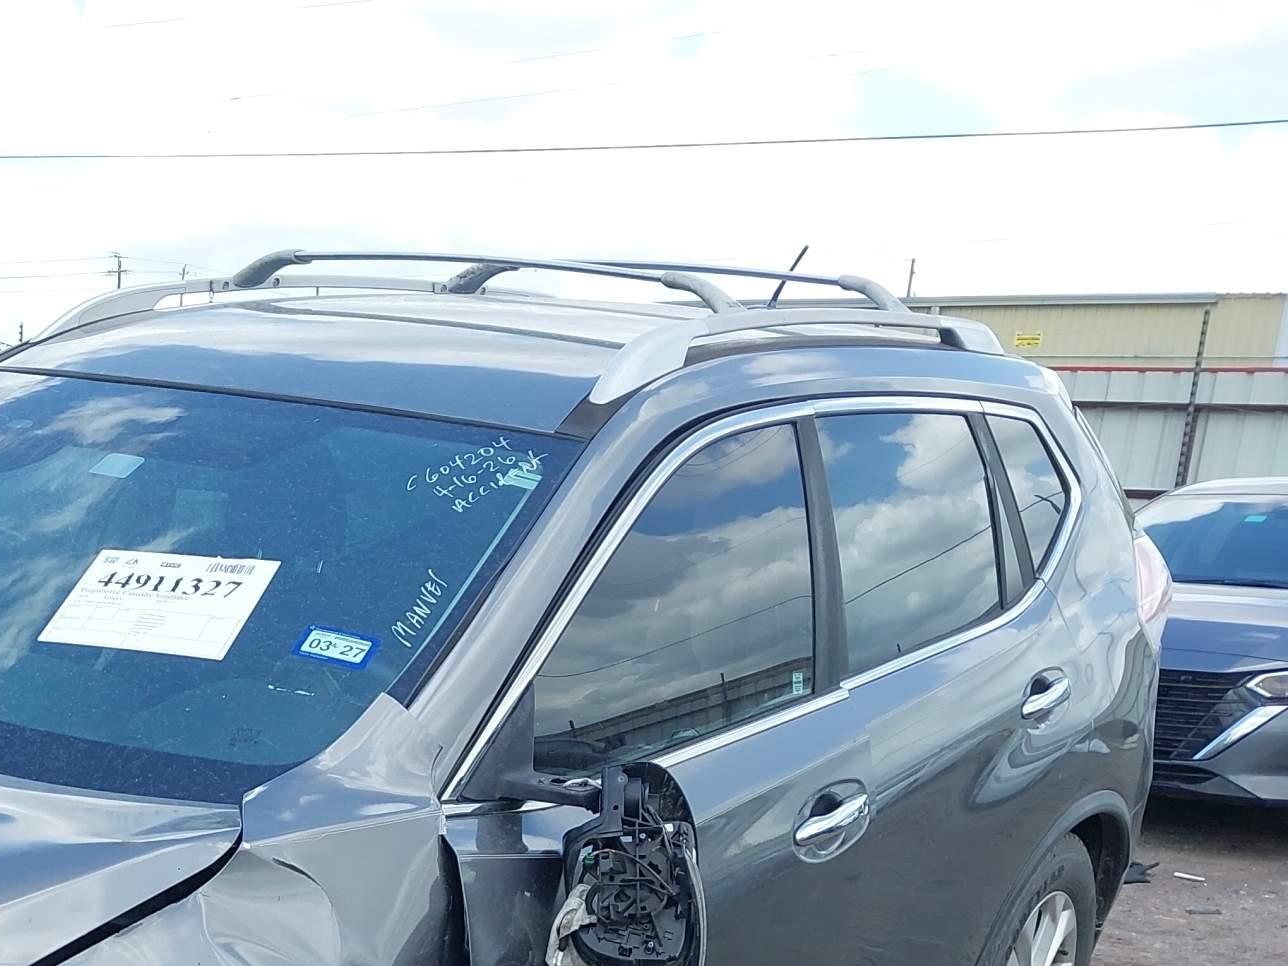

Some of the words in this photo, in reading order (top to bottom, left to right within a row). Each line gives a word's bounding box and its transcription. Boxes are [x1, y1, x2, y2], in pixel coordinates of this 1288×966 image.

[97, 571, 245, 599] 44911327
[308, 638, 333, 652] 03
[338, 644, 368, 659] 27
